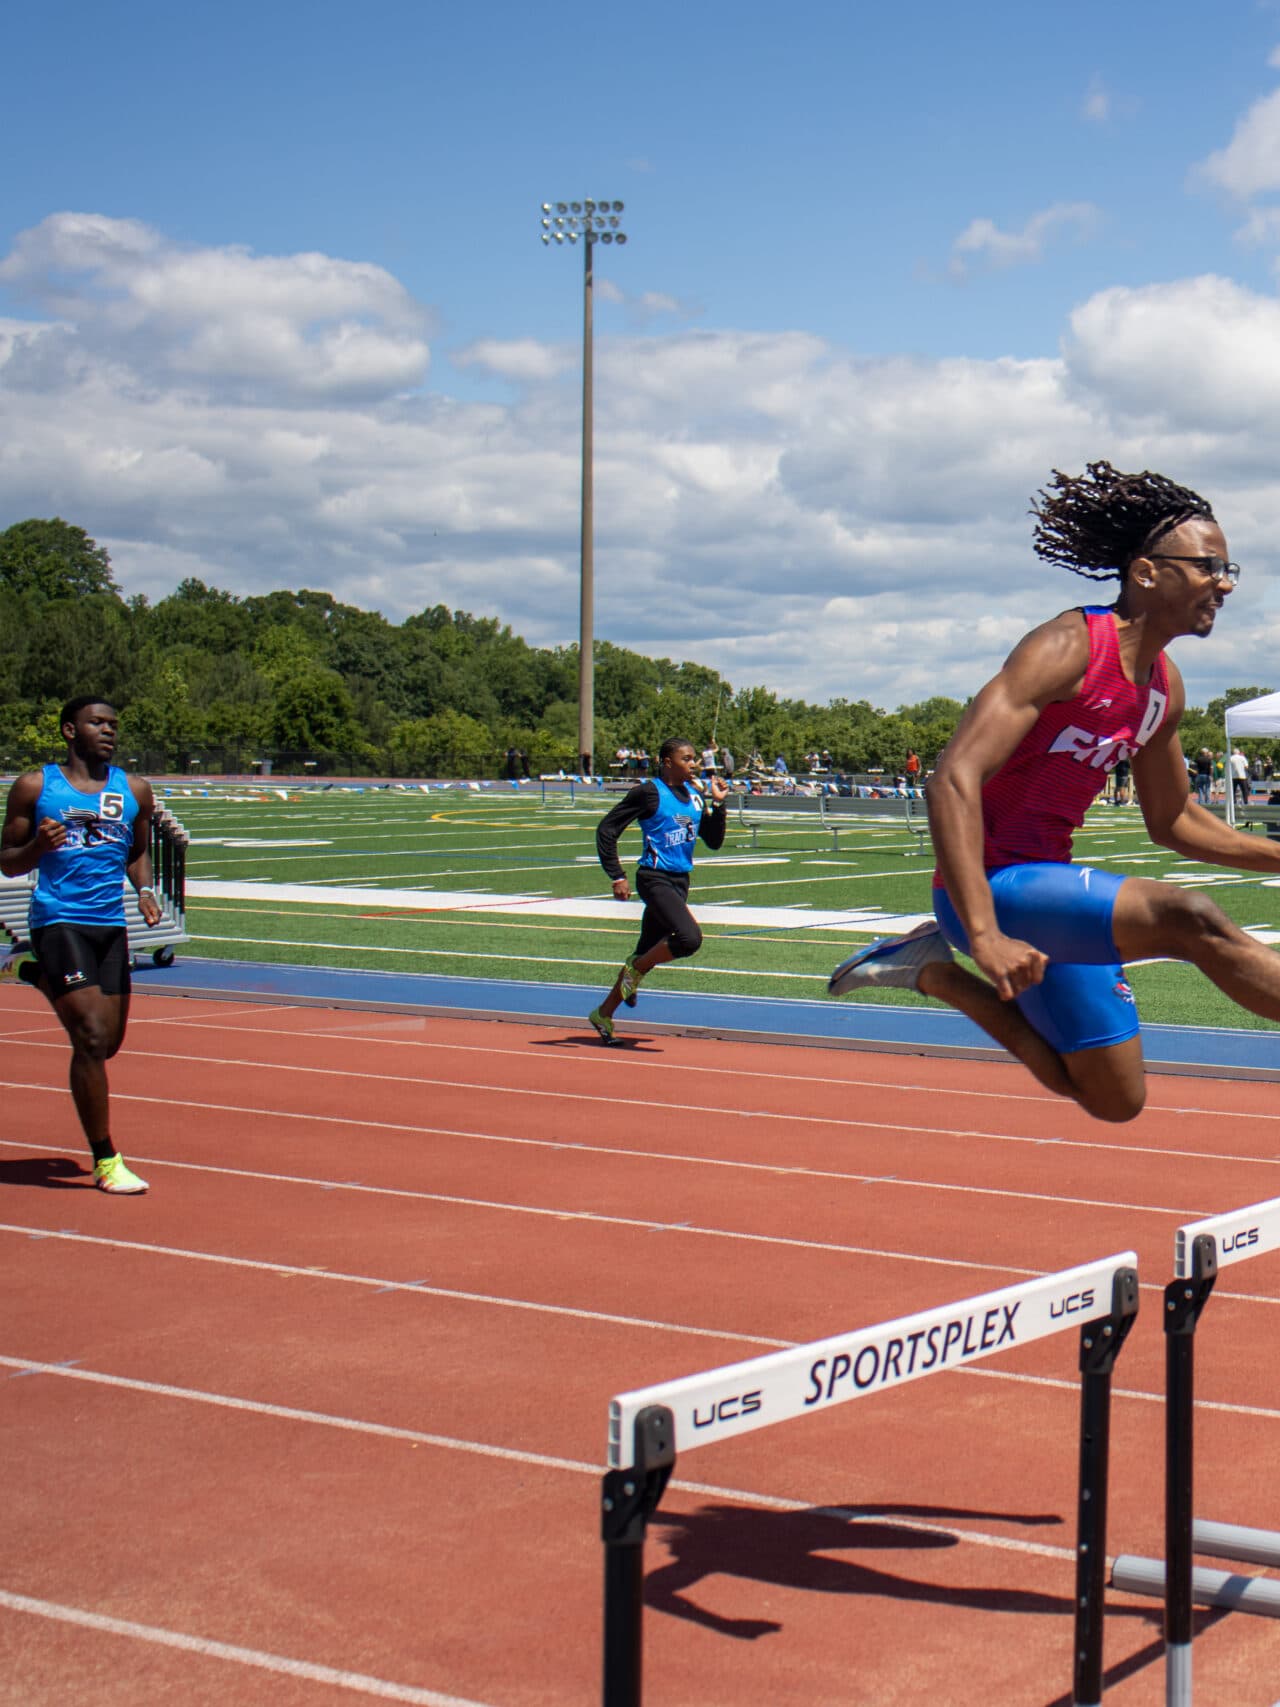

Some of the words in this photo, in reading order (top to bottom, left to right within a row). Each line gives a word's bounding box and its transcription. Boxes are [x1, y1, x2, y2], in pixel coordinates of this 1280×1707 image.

[102, 795, 123, 818] 5
[1222, 1226, 1260, 1253] UCS
[693, 1390, 763, 1429] UCS
[803, 1301, 1021, 1405] SPORTSPLEX
[1049, 1288, 1096, 1319] UCS
